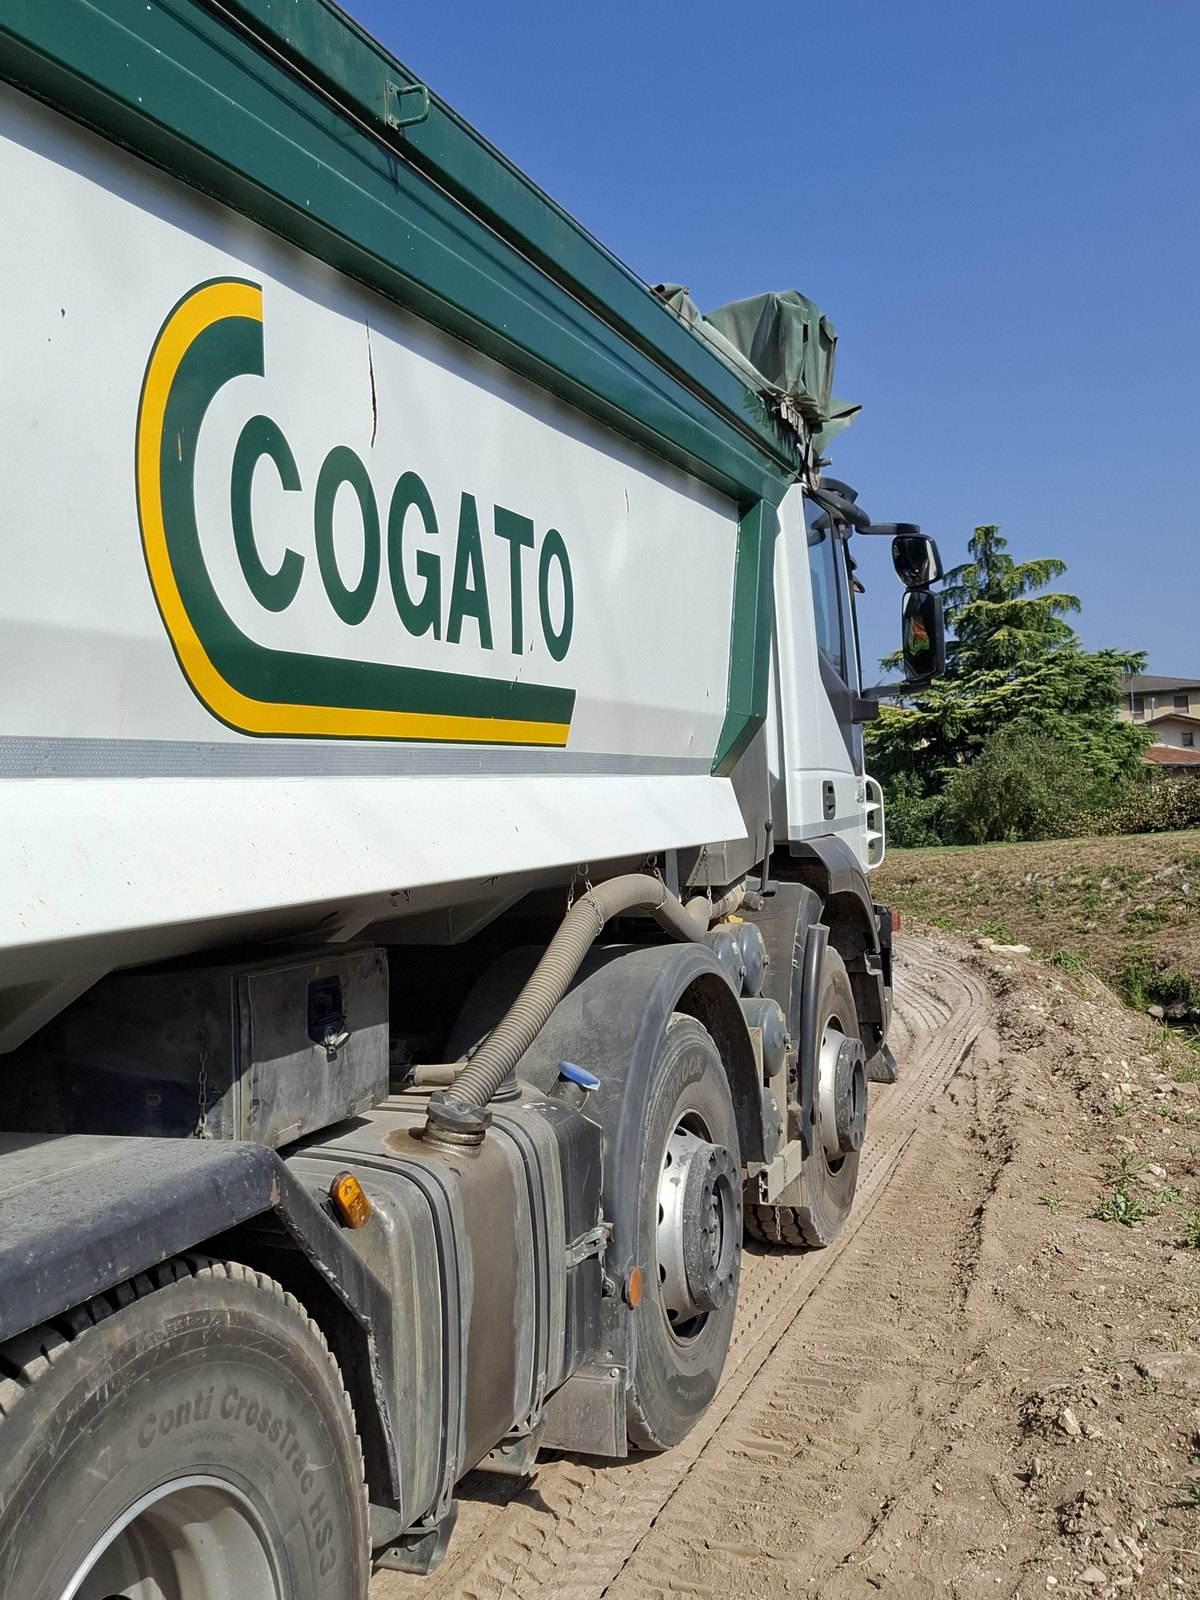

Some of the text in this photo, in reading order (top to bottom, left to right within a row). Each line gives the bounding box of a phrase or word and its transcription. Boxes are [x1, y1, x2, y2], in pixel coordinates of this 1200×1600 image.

[230, 414, 574, 662] COGATO
[138, 1386, 215, 1449] Conti
[308, 1491, 337, 1578] HS3
